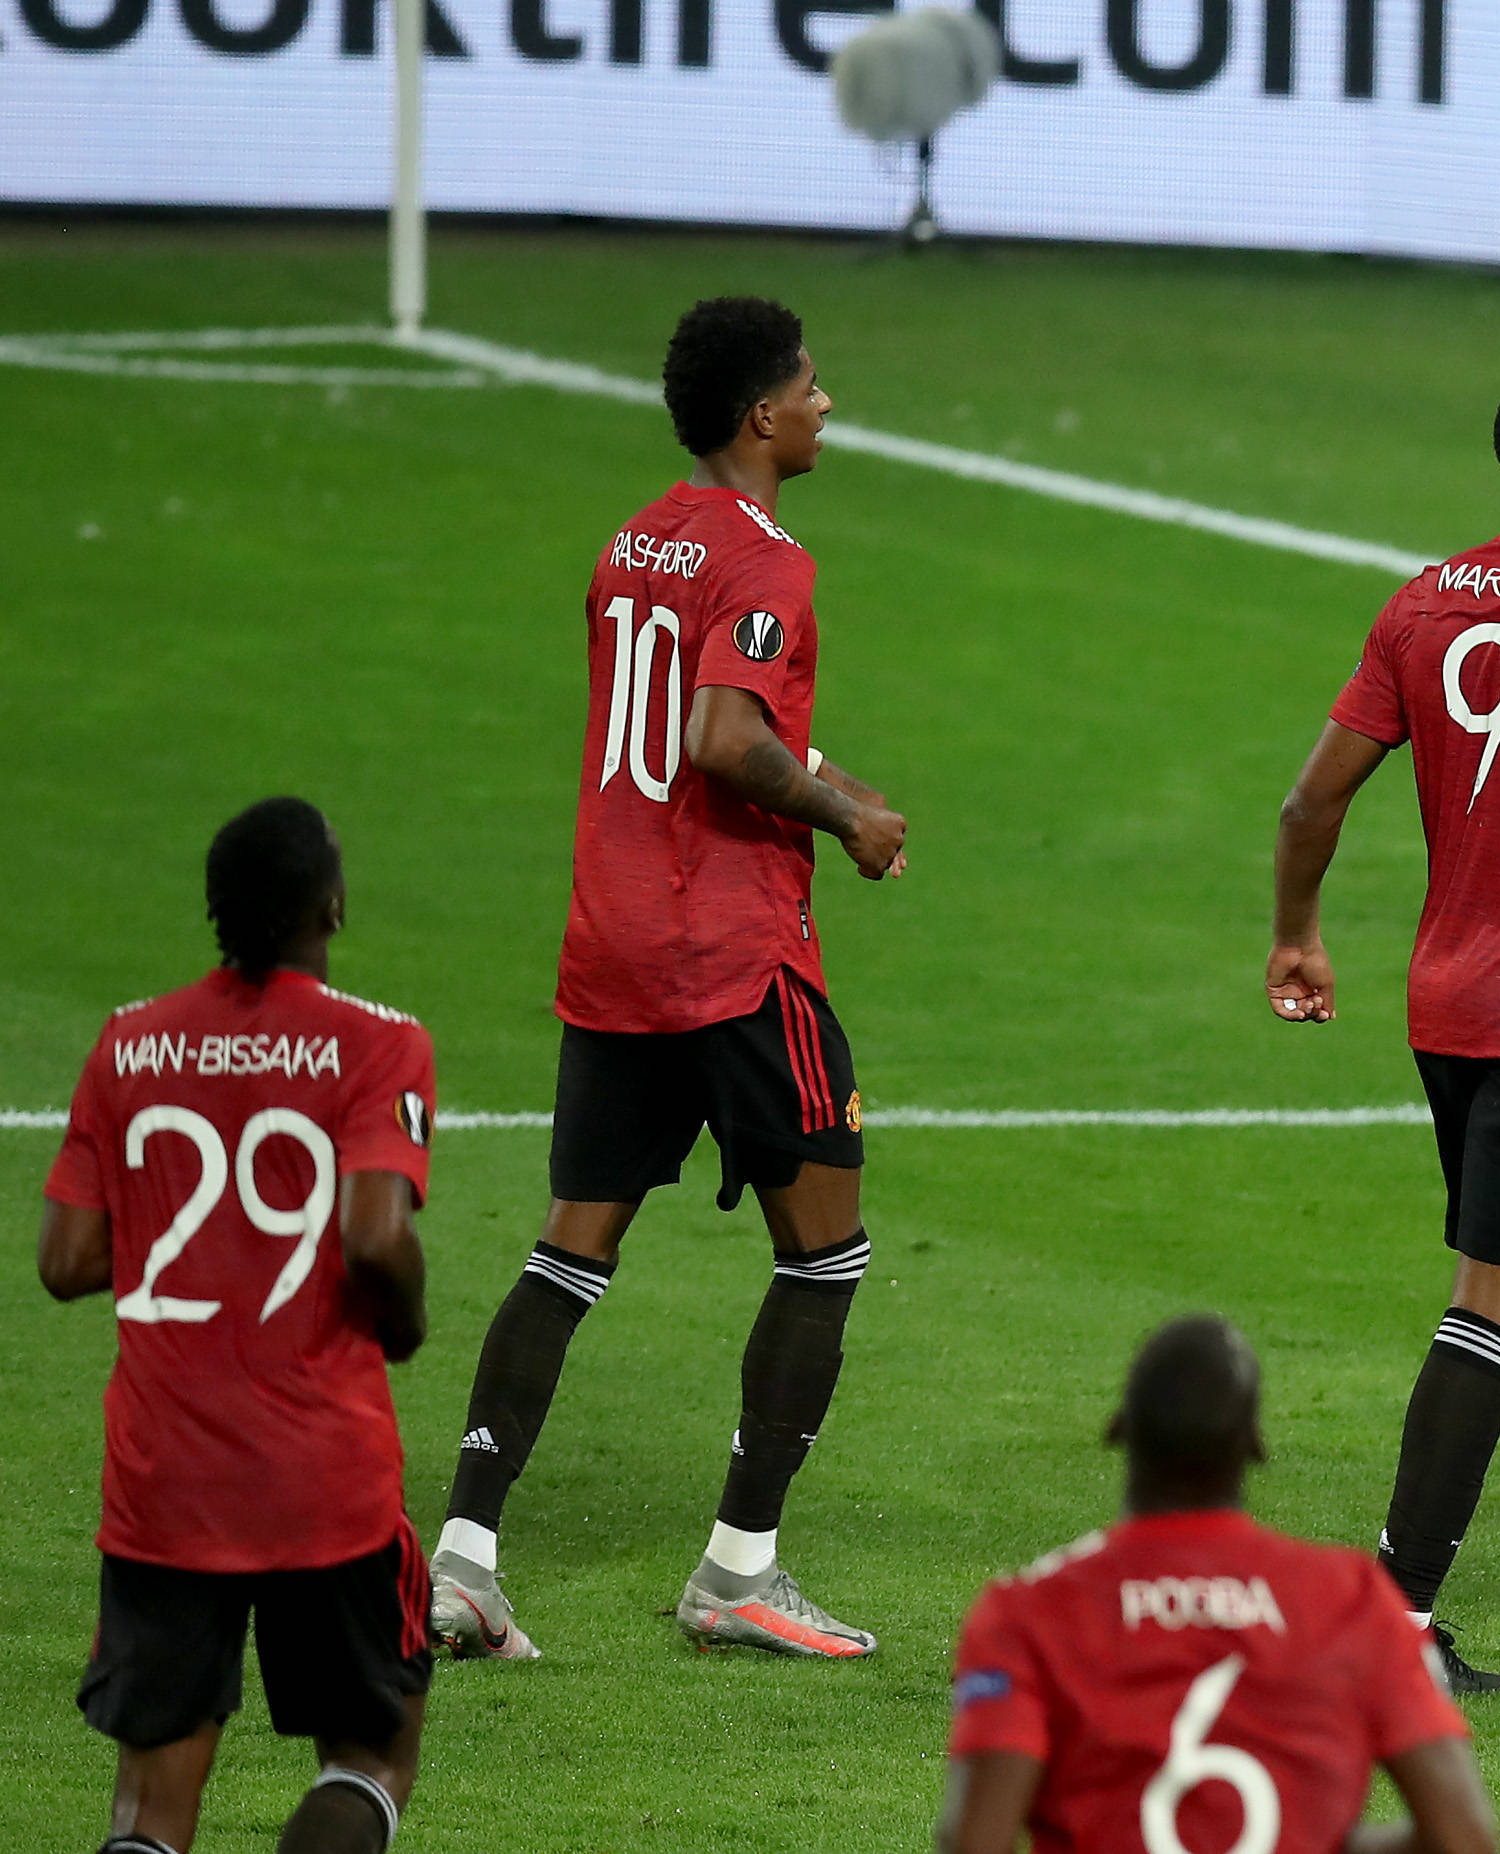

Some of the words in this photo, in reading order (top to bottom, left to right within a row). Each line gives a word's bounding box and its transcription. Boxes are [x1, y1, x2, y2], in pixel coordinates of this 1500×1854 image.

[600, 596, 681, 803] 10
[114, 1031, 341, 1080] WAN-BISSAKA
[115, 1104, 337, 1325] 29
[1140, 1652, 1282, 1854] 6
